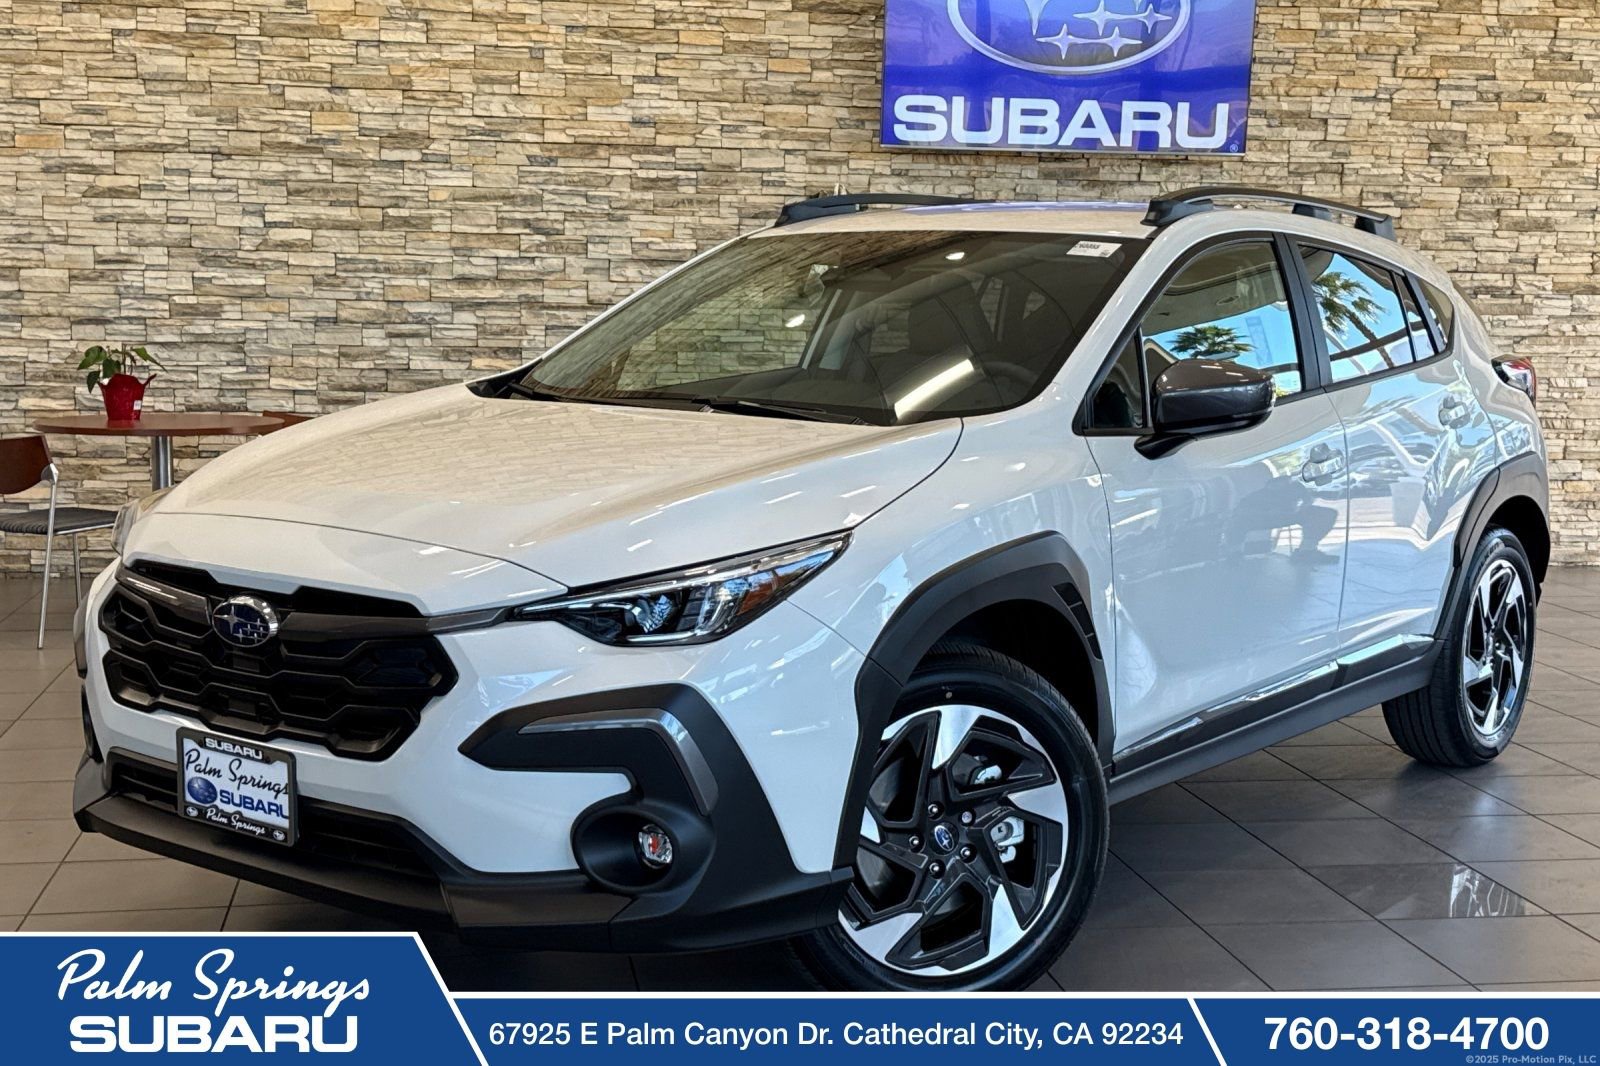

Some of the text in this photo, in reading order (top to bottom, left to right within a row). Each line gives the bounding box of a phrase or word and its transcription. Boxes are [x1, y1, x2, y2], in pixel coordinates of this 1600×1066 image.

[893, 94, 1229, 149] SUBARU
[205, 738, 263, 760] SUBARU
[185, 748, 289, 800] Palm Springs
[206, 808, 266, 836] Palm Springs
